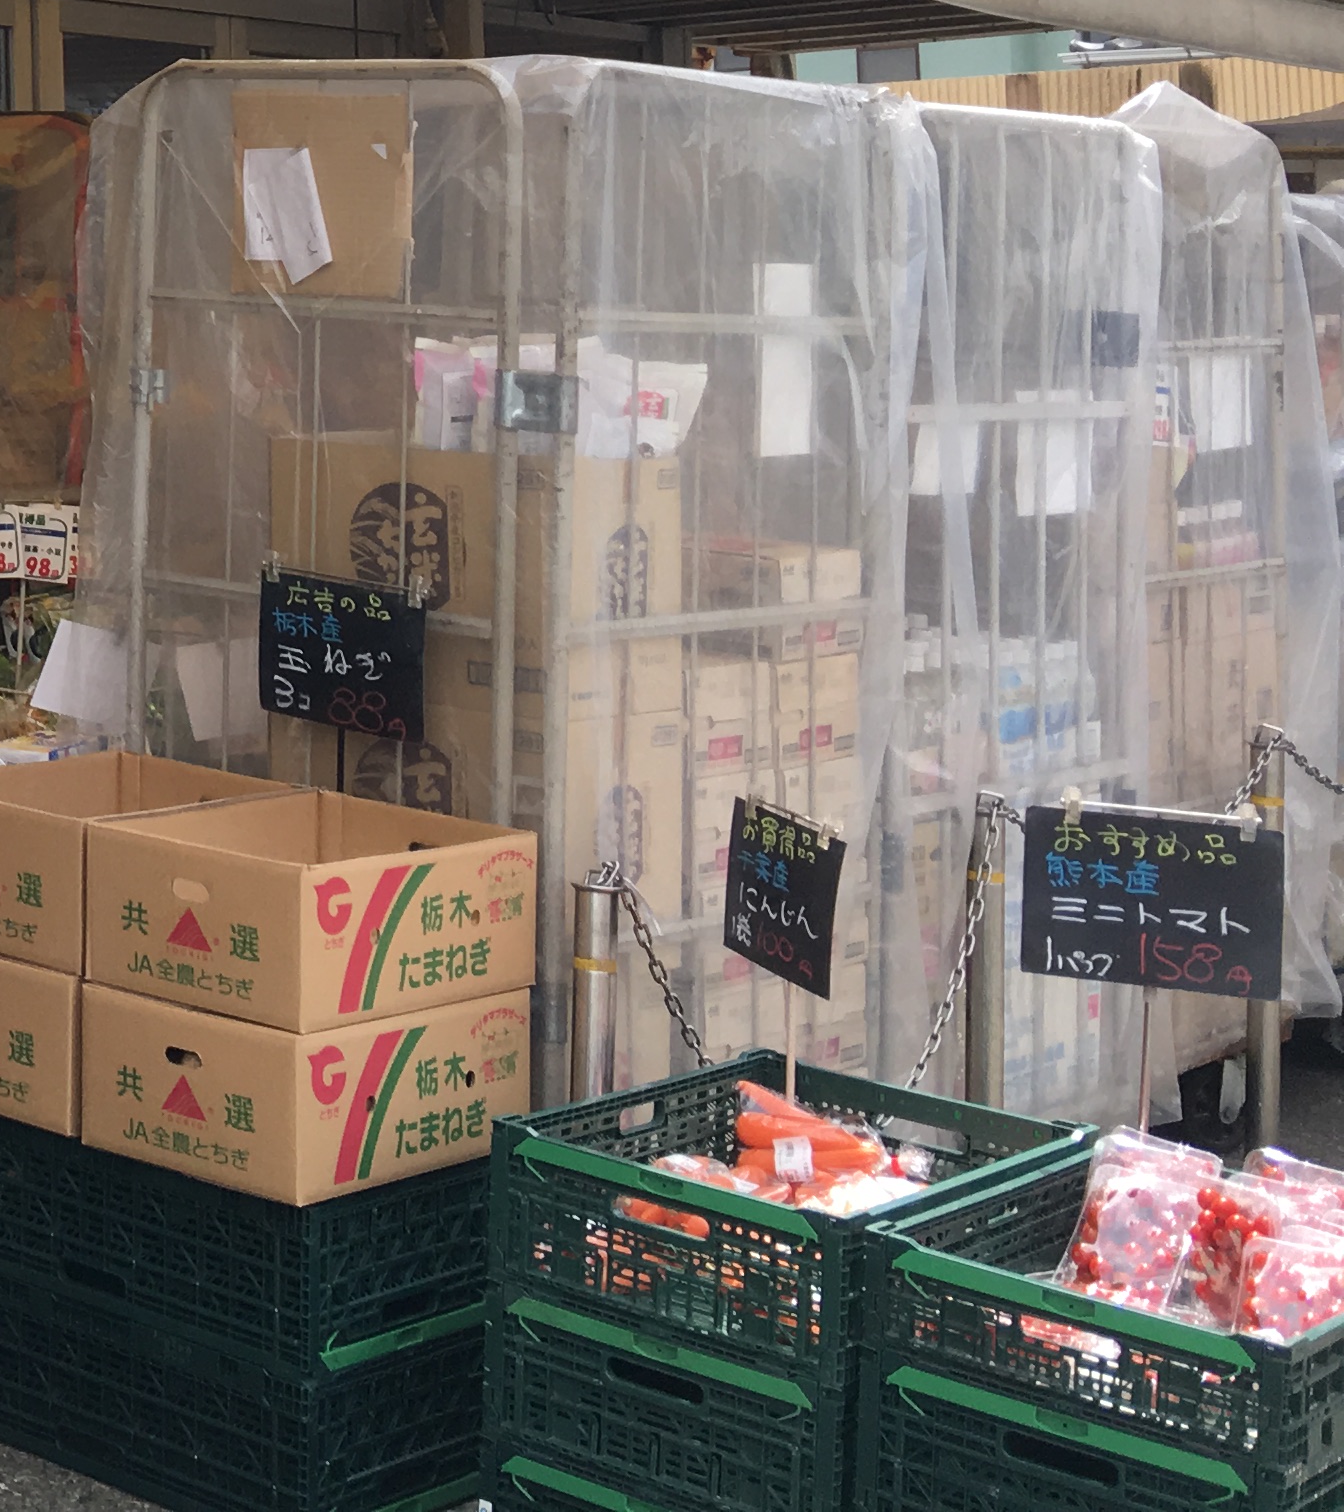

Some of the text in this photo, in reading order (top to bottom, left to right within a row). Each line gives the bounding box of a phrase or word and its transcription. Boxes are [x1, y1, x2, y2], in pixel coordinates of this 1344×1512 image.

[286, 580, 392, 621] 広告の品
[742, 815, 817, 865] お買得品
[1053, 820, 1238, 866] おすすめ品
[16, 872, 44, 908] 選
[1045, 851, 1161, 897] 熊本産
[121, 899, 261, 963] 共 選
[420, 890, 473, 936] 栃木
[738, 881, 819, 940] にんじん
[1051, 895, 1252, 937] ミニトマト
[398, 936, 493, 993] たまねぎ
[7, 1030, 36, 1068] 選
[116, 1064, 257, 1134] 共 選
[415, 1051, 467, 1100] 栃木
[395, 1096, 488, 1159] たまねぎ
